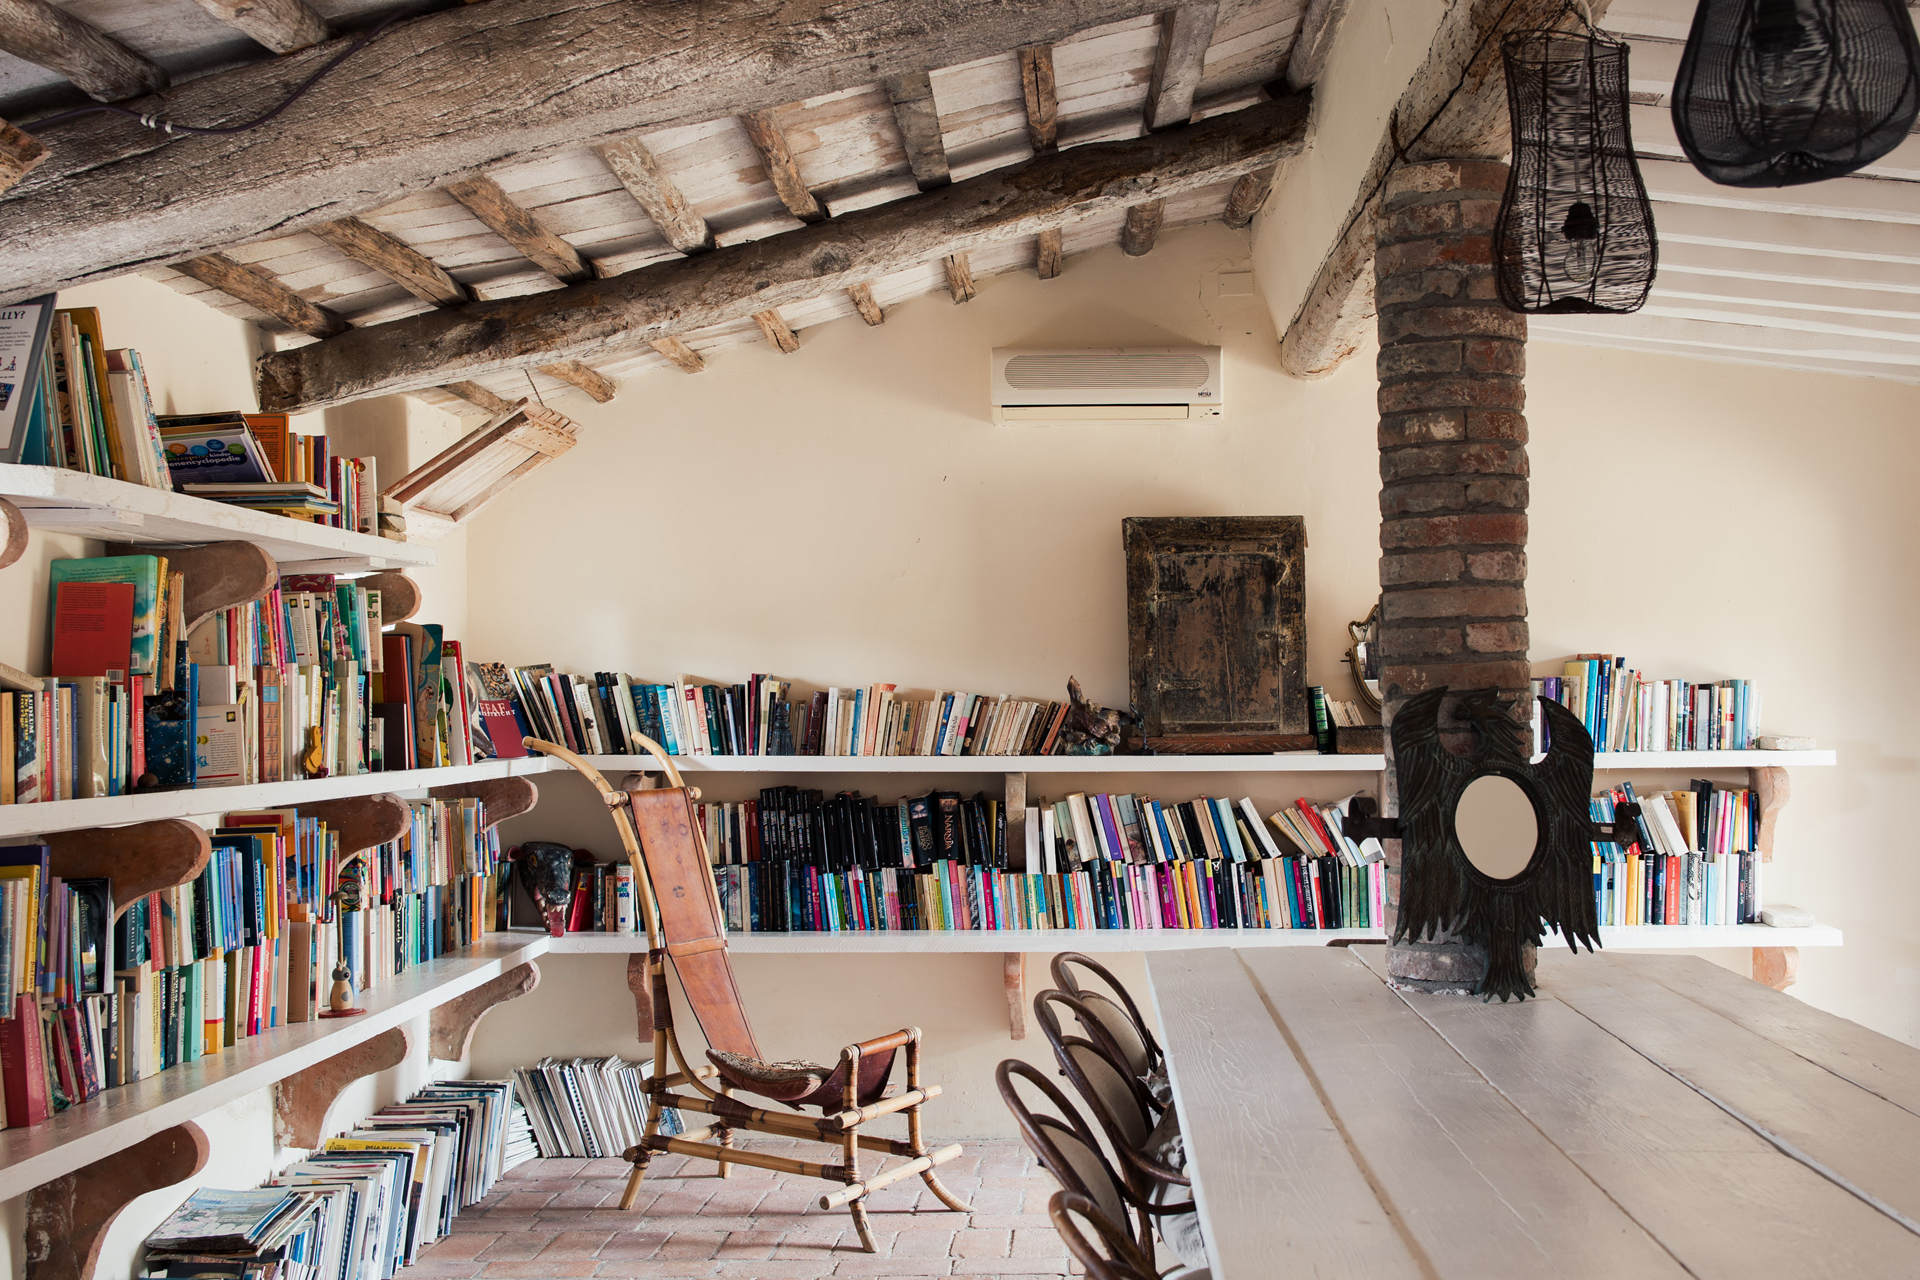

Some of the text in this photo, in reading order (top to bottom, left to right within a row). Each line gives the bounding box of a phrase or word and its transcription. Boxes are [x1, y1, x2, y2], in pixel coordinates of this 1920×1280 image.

[0, 310, 26, 320] LLY?
[168, 456, 241, 467] enencyclopedie
[479, 702, 506, 713] EFAF
[634, 695, 643, 708] De
[660, 697, 673, 736] De Goten
[698, 709, 706, 727] Karel
[943, 814, 954, 850] NARNIA
